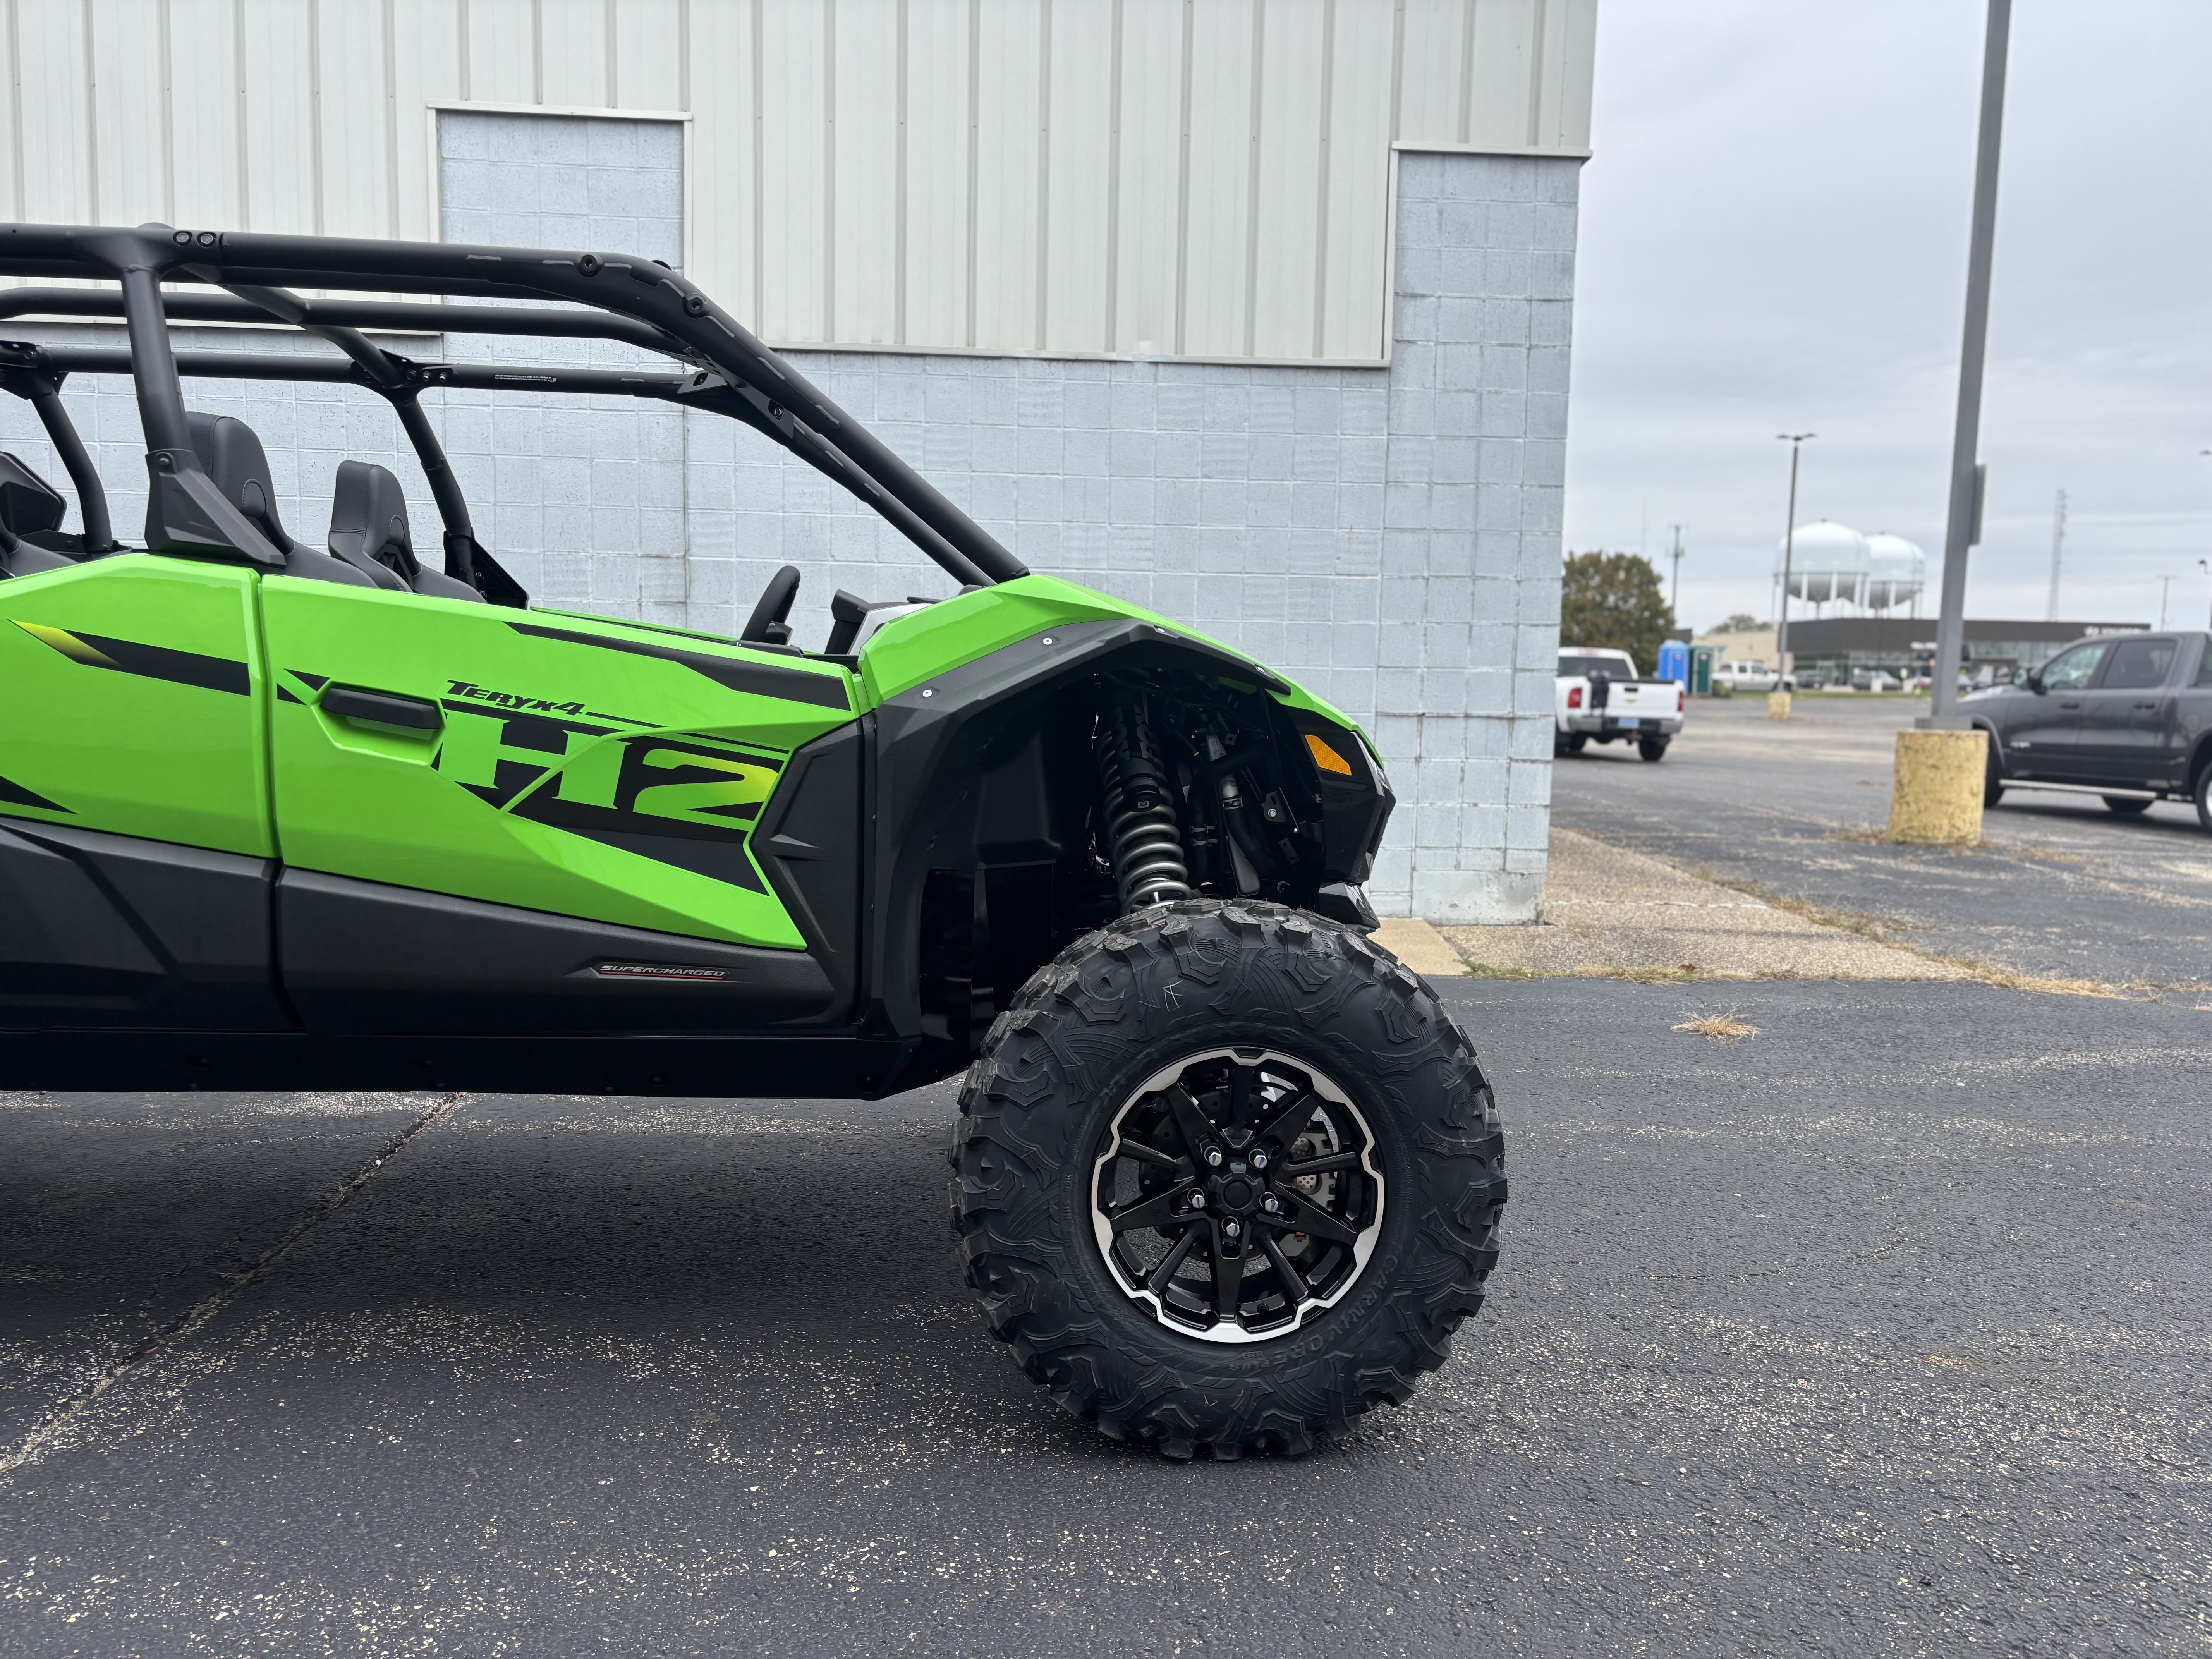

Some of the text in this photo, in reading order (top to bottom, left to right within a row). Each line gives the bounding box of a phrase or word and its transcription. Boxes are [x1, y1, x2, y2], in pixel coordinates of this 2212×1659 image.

[438, 709, 778, 831] H2
[600, 965, 725, 976] SUPERCHARGED
[1228, 1254, 1398, 1370] CARNIVORE PLUS
